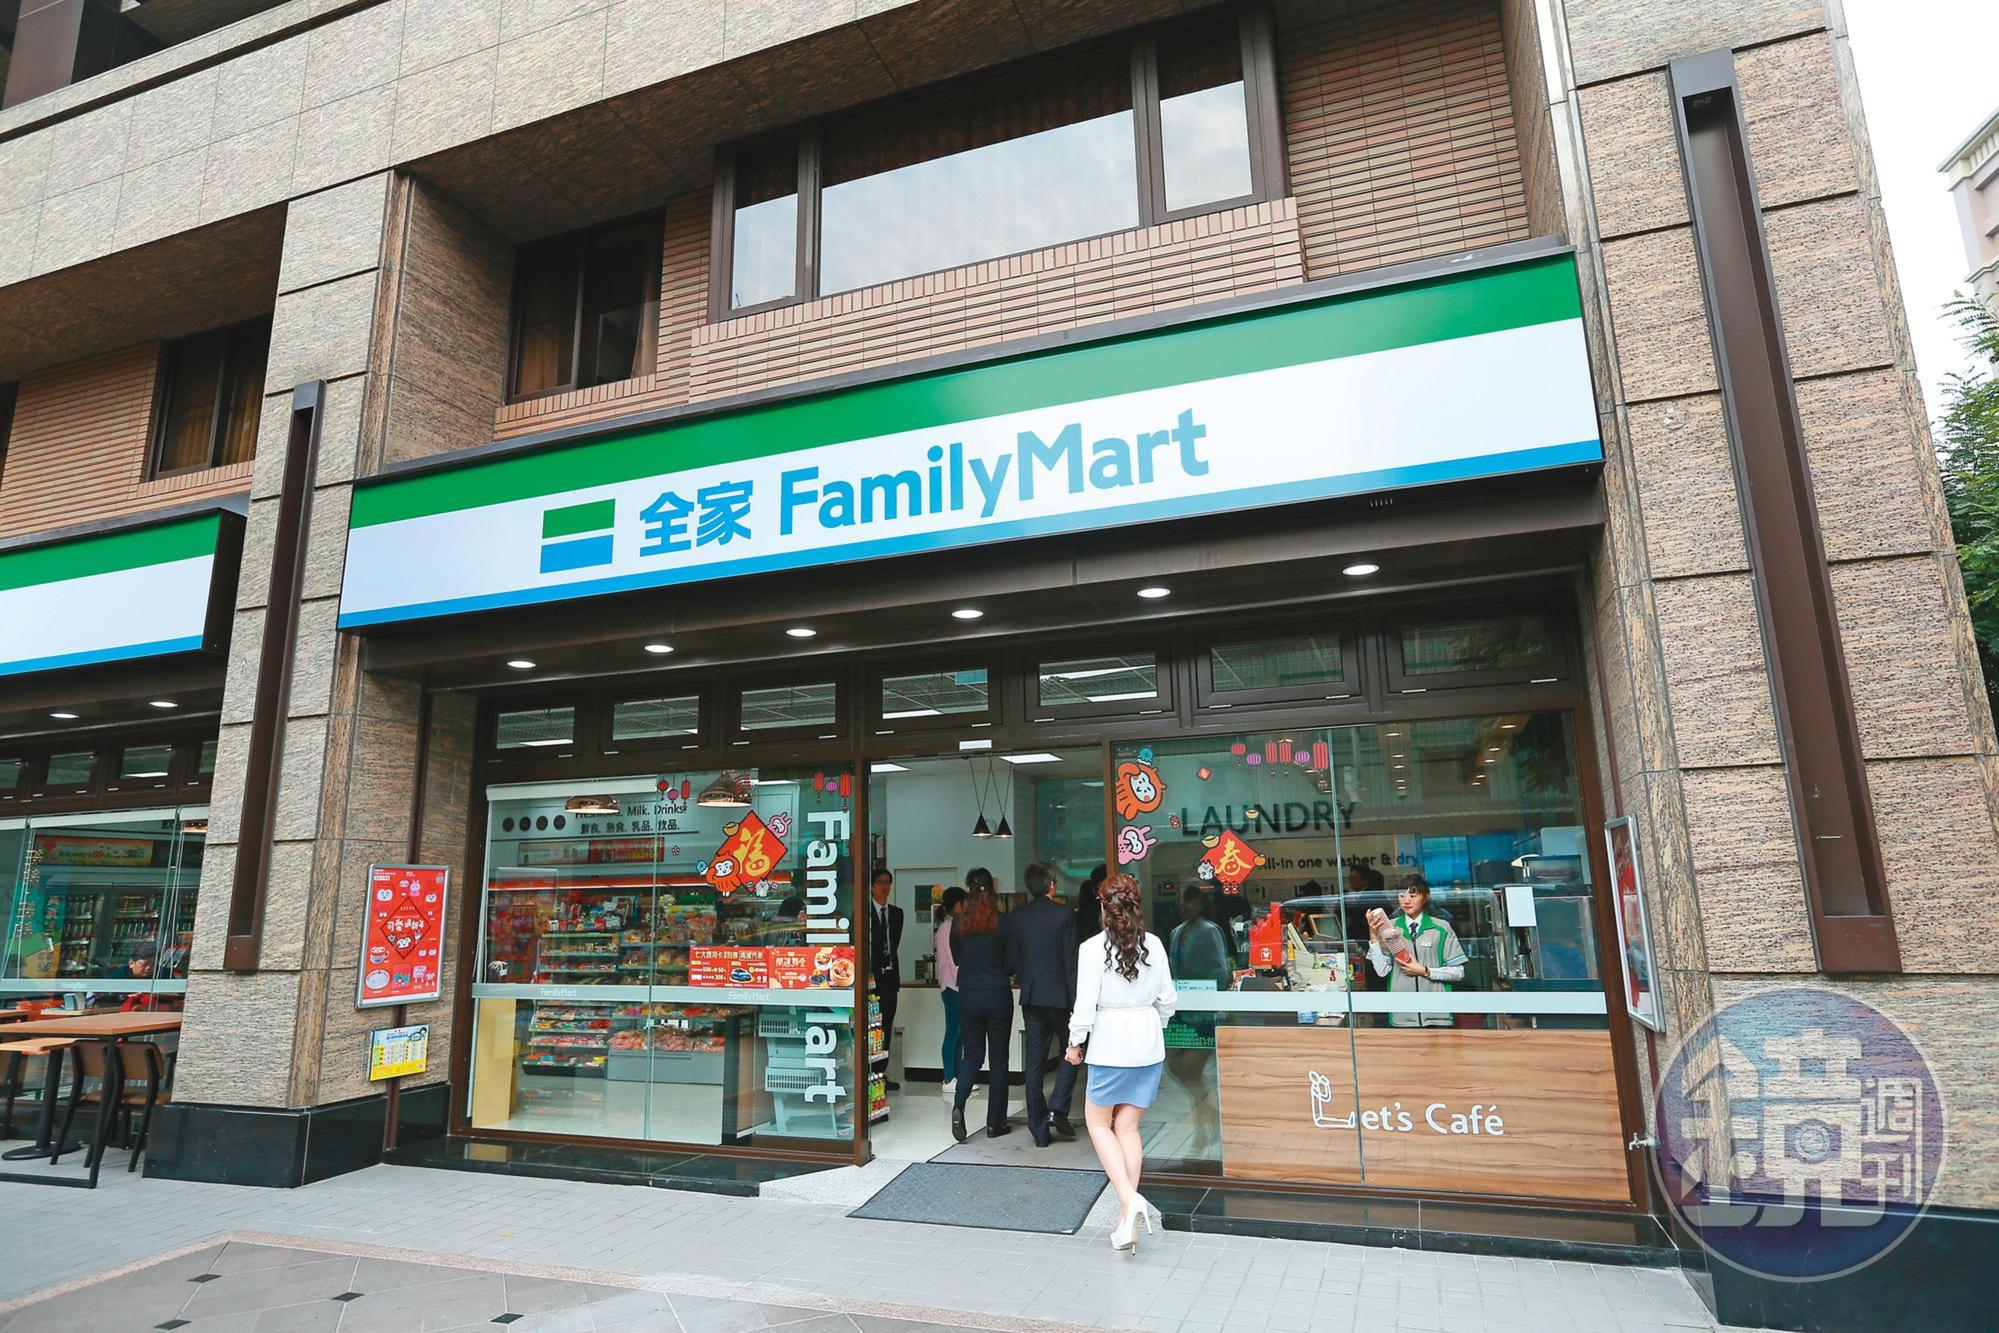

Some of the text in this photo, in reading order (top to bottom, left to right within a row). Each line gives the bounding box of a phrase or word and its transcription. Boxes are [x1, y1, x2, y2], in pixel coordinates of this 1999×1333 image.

[639, 409, 1209, 557] 全家 FamilyMart
[1182, 800, 1360, 836] LAUNDRY
[733, 827, 770, 877] 福
[1215, 838, 1251, 876] 春
[1264, 857, 1294, 870] ll-in
[1297, 858, 1322, 869] one
[1327, 854, 1376, 868] washer
[1381, 853, 1391, 866] &
[805, 811, 850, 1103] Familart
[1308, 1070, 1505, 1137] Let's Café
